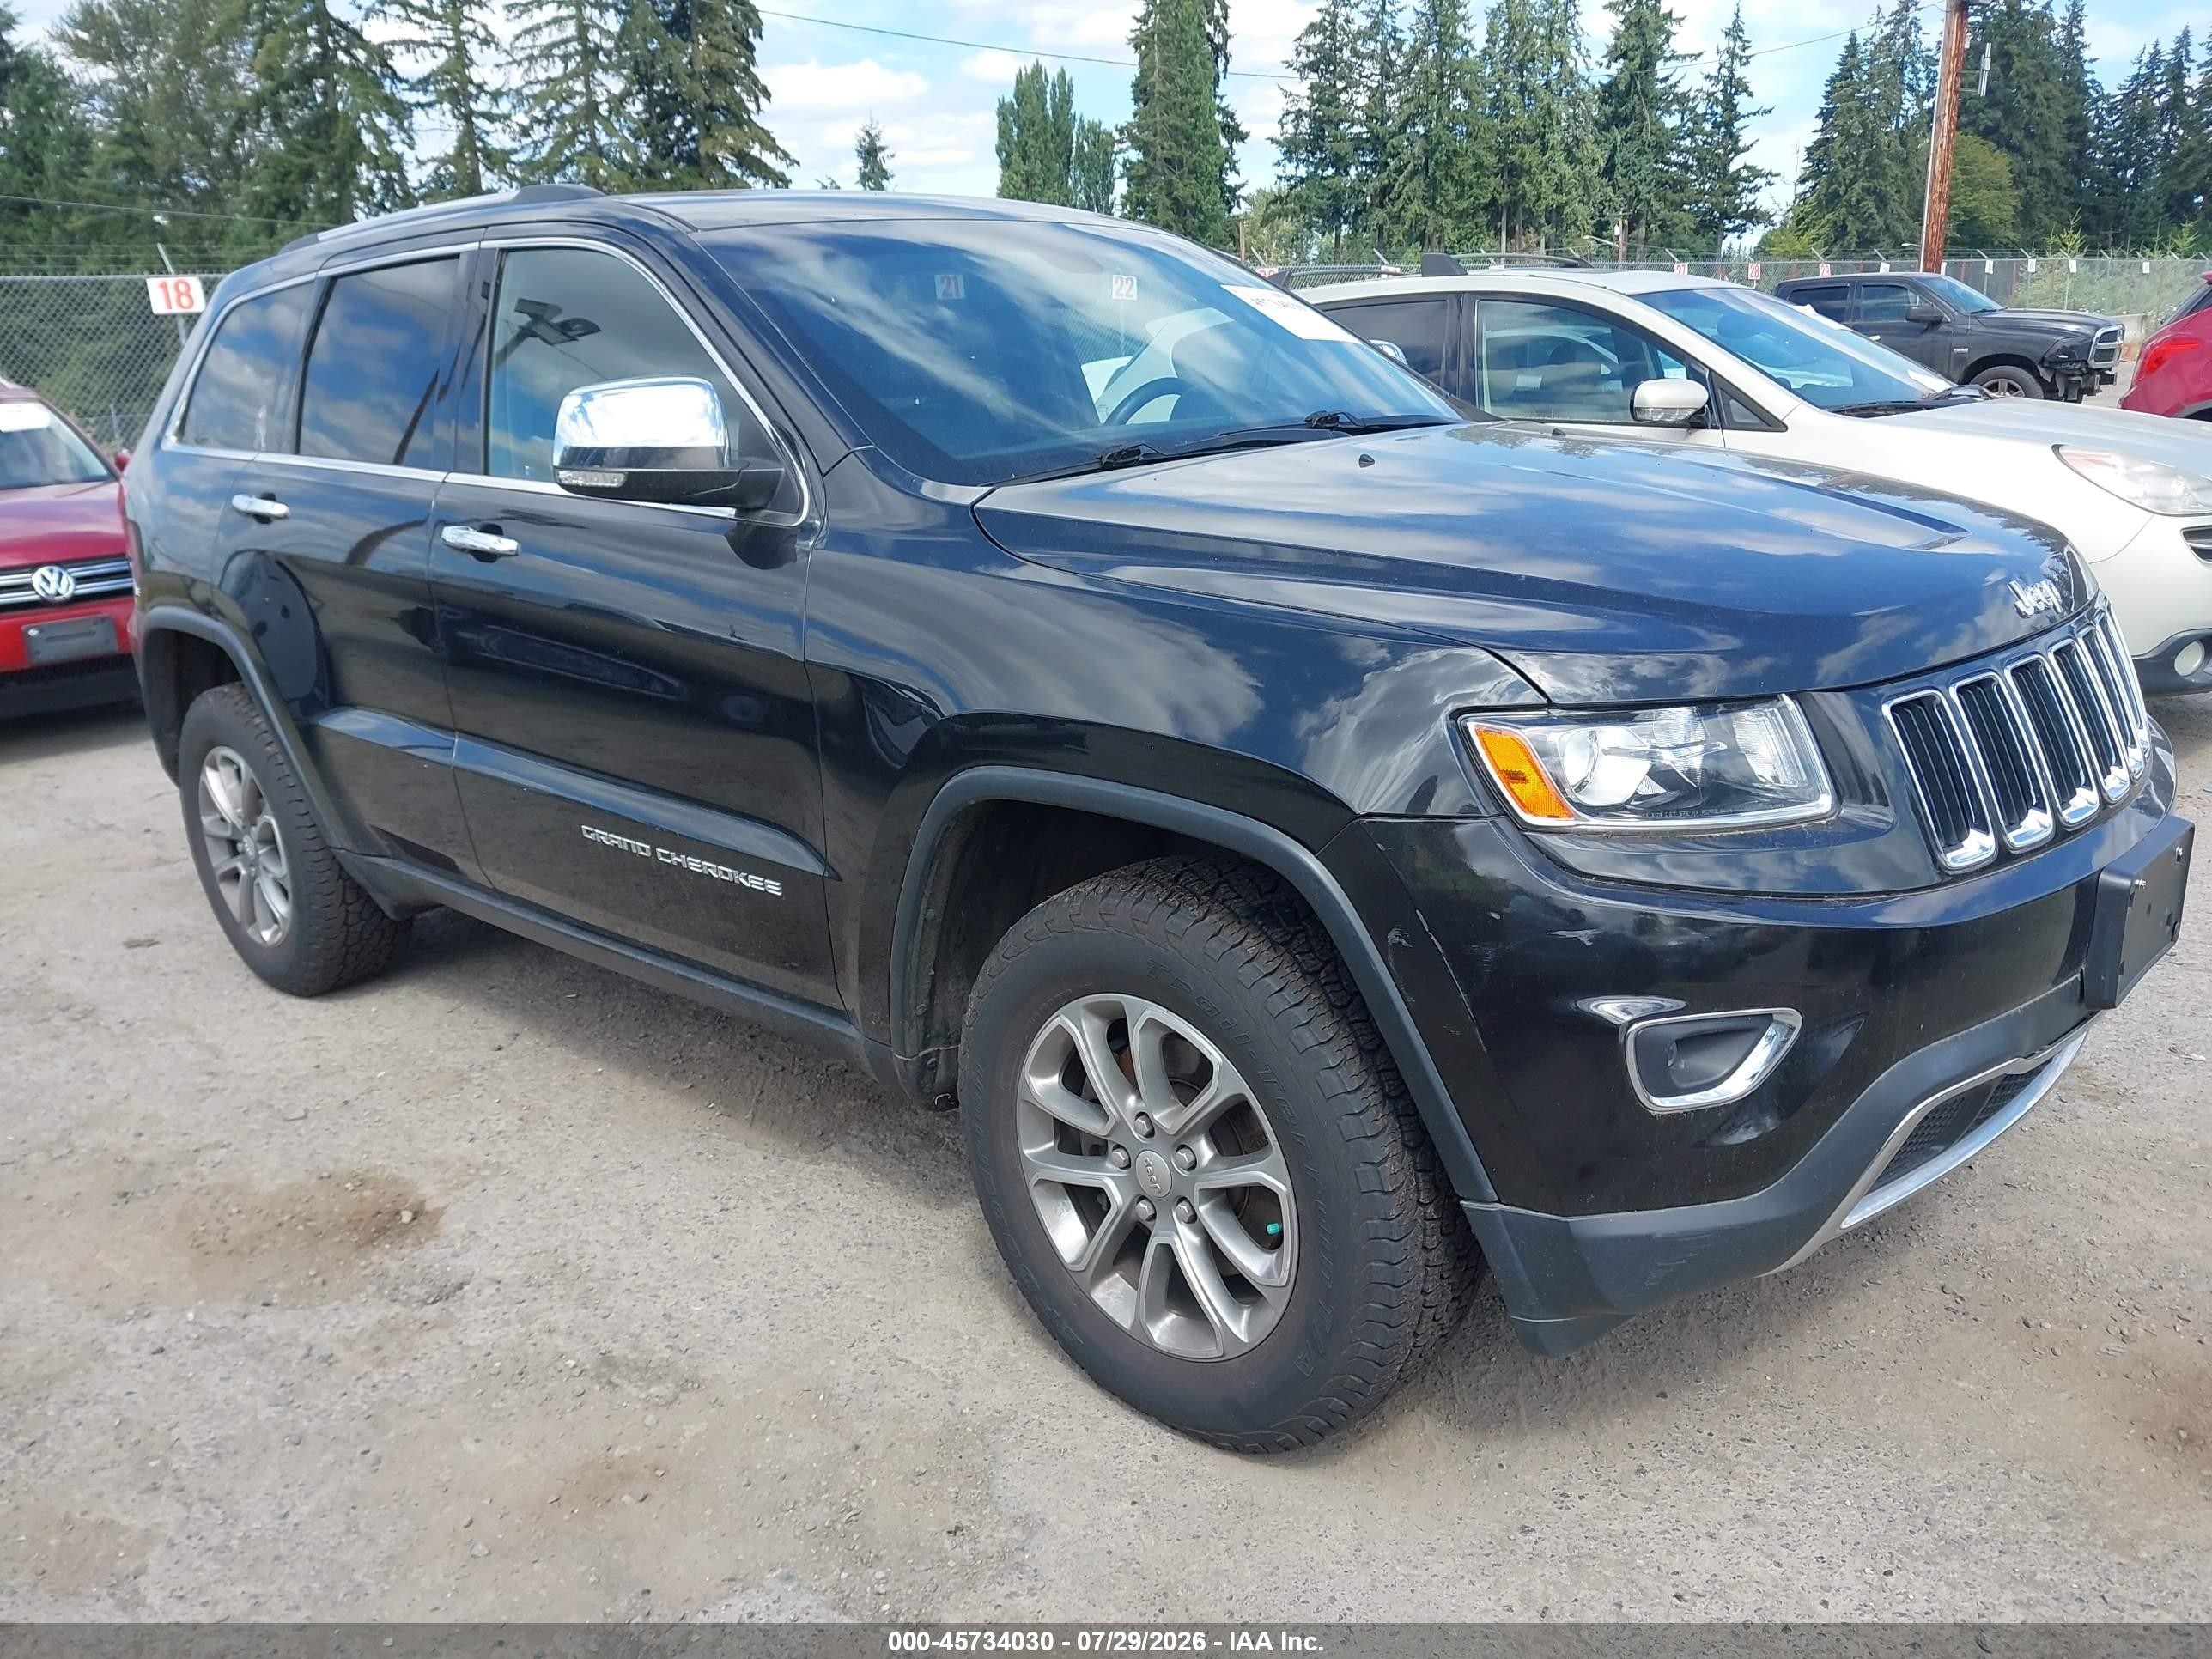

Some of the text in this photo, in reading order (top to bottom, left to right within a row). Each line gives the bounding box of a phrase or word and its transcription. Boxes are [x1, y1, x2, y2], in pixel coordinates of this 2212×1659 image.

[1749, 264, 1760, 278] 28
[1820, 264, 1831, 276] 29
[158, 279, 194, 310] 18
[939, 274, 961, 297] 21
[1114, 276, 1134, 298] 22
[2006, 579, 2063, 618] Jeep
[580, 824, 783, 897] GRAND CHEROKEE
